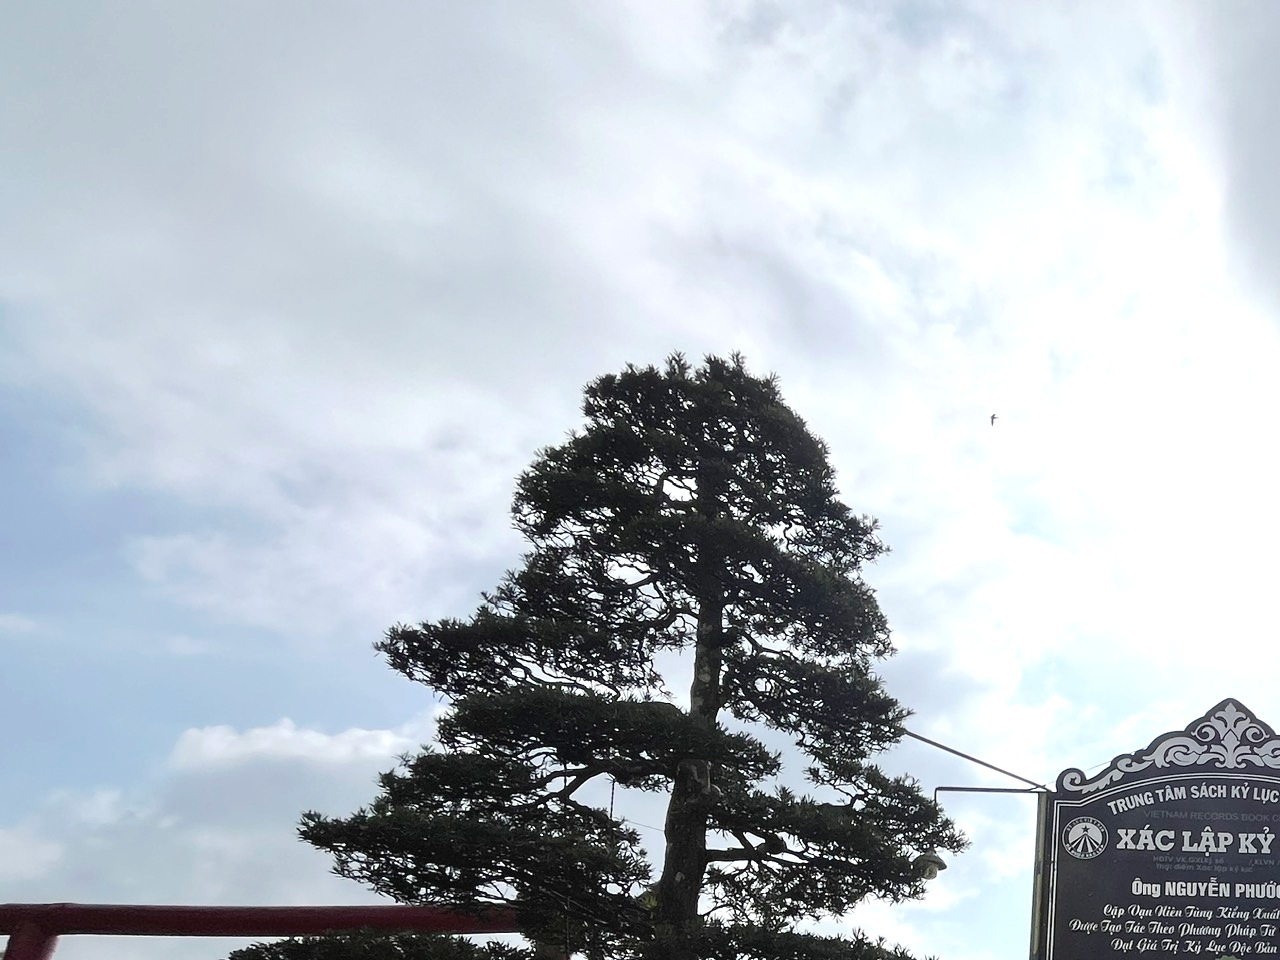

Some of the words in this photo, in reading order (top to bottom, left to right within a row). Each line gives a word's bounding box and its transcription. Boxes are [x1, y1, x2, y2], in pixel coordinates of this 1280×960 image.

[1107, 791, 1154, 815] TRUNG
[1155, 785, 1187, 802] TÂM
[1190, 782, 1226, 799] SÁCH
[1231, 782, 1250, 799] KỶ
[1253, 787, 1280, 804] LỤC
[1143, 809, 1188, 819] VIETNAM
[1190, 811, 1239, 821] RECORDS
[1241, 813, 1270, 822] BOOK
[1116, 824, 1175, 852] XÁC
[1181, 825, 1234, 857] LẬP
[1238, 826, 1275, 854] KỶ
[1131, 877, 1161, 898] Ông
[1164, 877, 1231, 898] NGUYỄN
[1103, 904, 1125, 919] Cặp
[1127, 905, 1153, 919] Vạn
[1154, 905, 1182, 918] Niên
[1184, 905, 1213, 921] Tùng
[1216, 906, 1250, 922] Kiểng
[1252, 907, 1280, 920] Xuất
[1068, 918, 1098, 935] Được
[1100, 919, 1122, 935] Tạo
[1124, 920, 1146, 934] Tác
[1147, 921, 1175, 935] Theo
[1178, 922, 1222, 938] Phương
[1225, 923, 1257, 938] Pháp
[1111, 938, 1134, 953] Đạt
[1136, 938, 1157, 954] Giá
[1161, 938, 1180, 955] Trị
[1205, 939, 1227, 955] Lục
[1229, 941, 1252, 956] Độc
[1254, 941, 1278, 954] Bản
